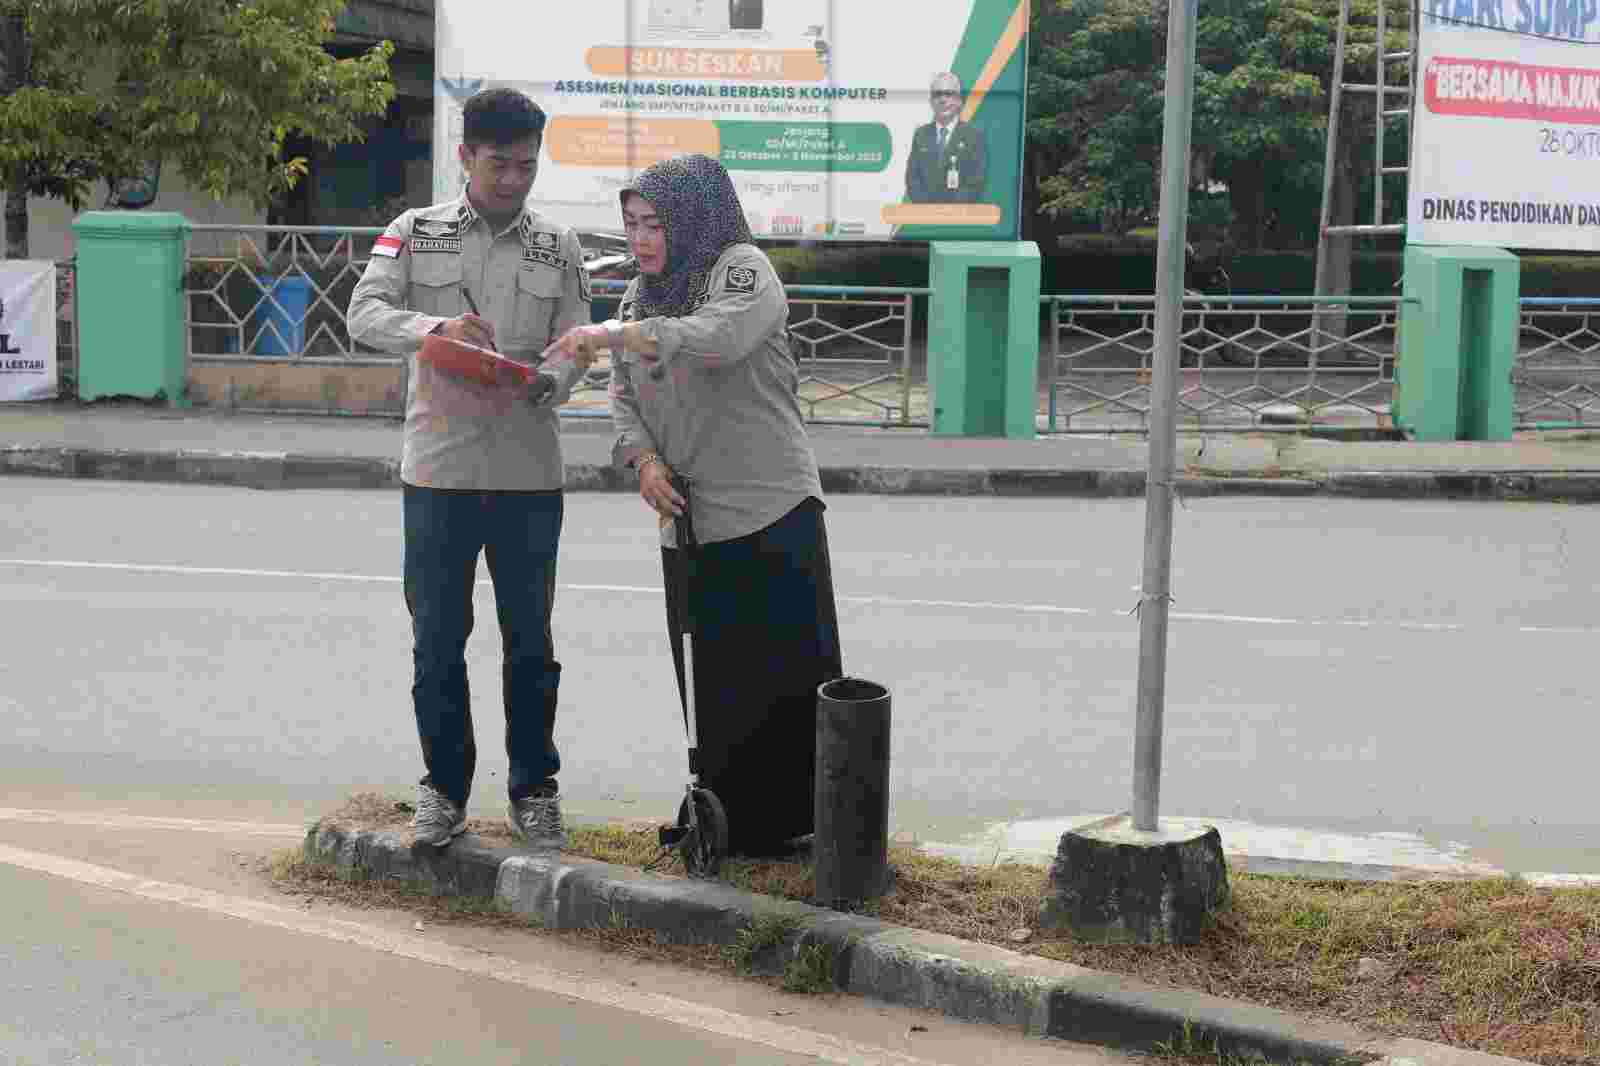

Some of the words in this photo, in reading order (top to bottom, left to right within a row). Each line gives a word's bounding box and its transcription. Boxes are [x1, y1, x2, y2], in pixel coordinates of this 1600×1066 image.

[631, 50, 784, 73] SUKSESKAN
[554, 80, 628, 96] ASESMEN
[632, 82, 714, 97] NASIONAL
[720, 85, 794, 99] BERBASIS
[800, 87, 887, 100] KOMPUTER
[1424, 199, 1476, 221] DINAS
[1481, 201, 1573, 225] PENDIDIKAN
